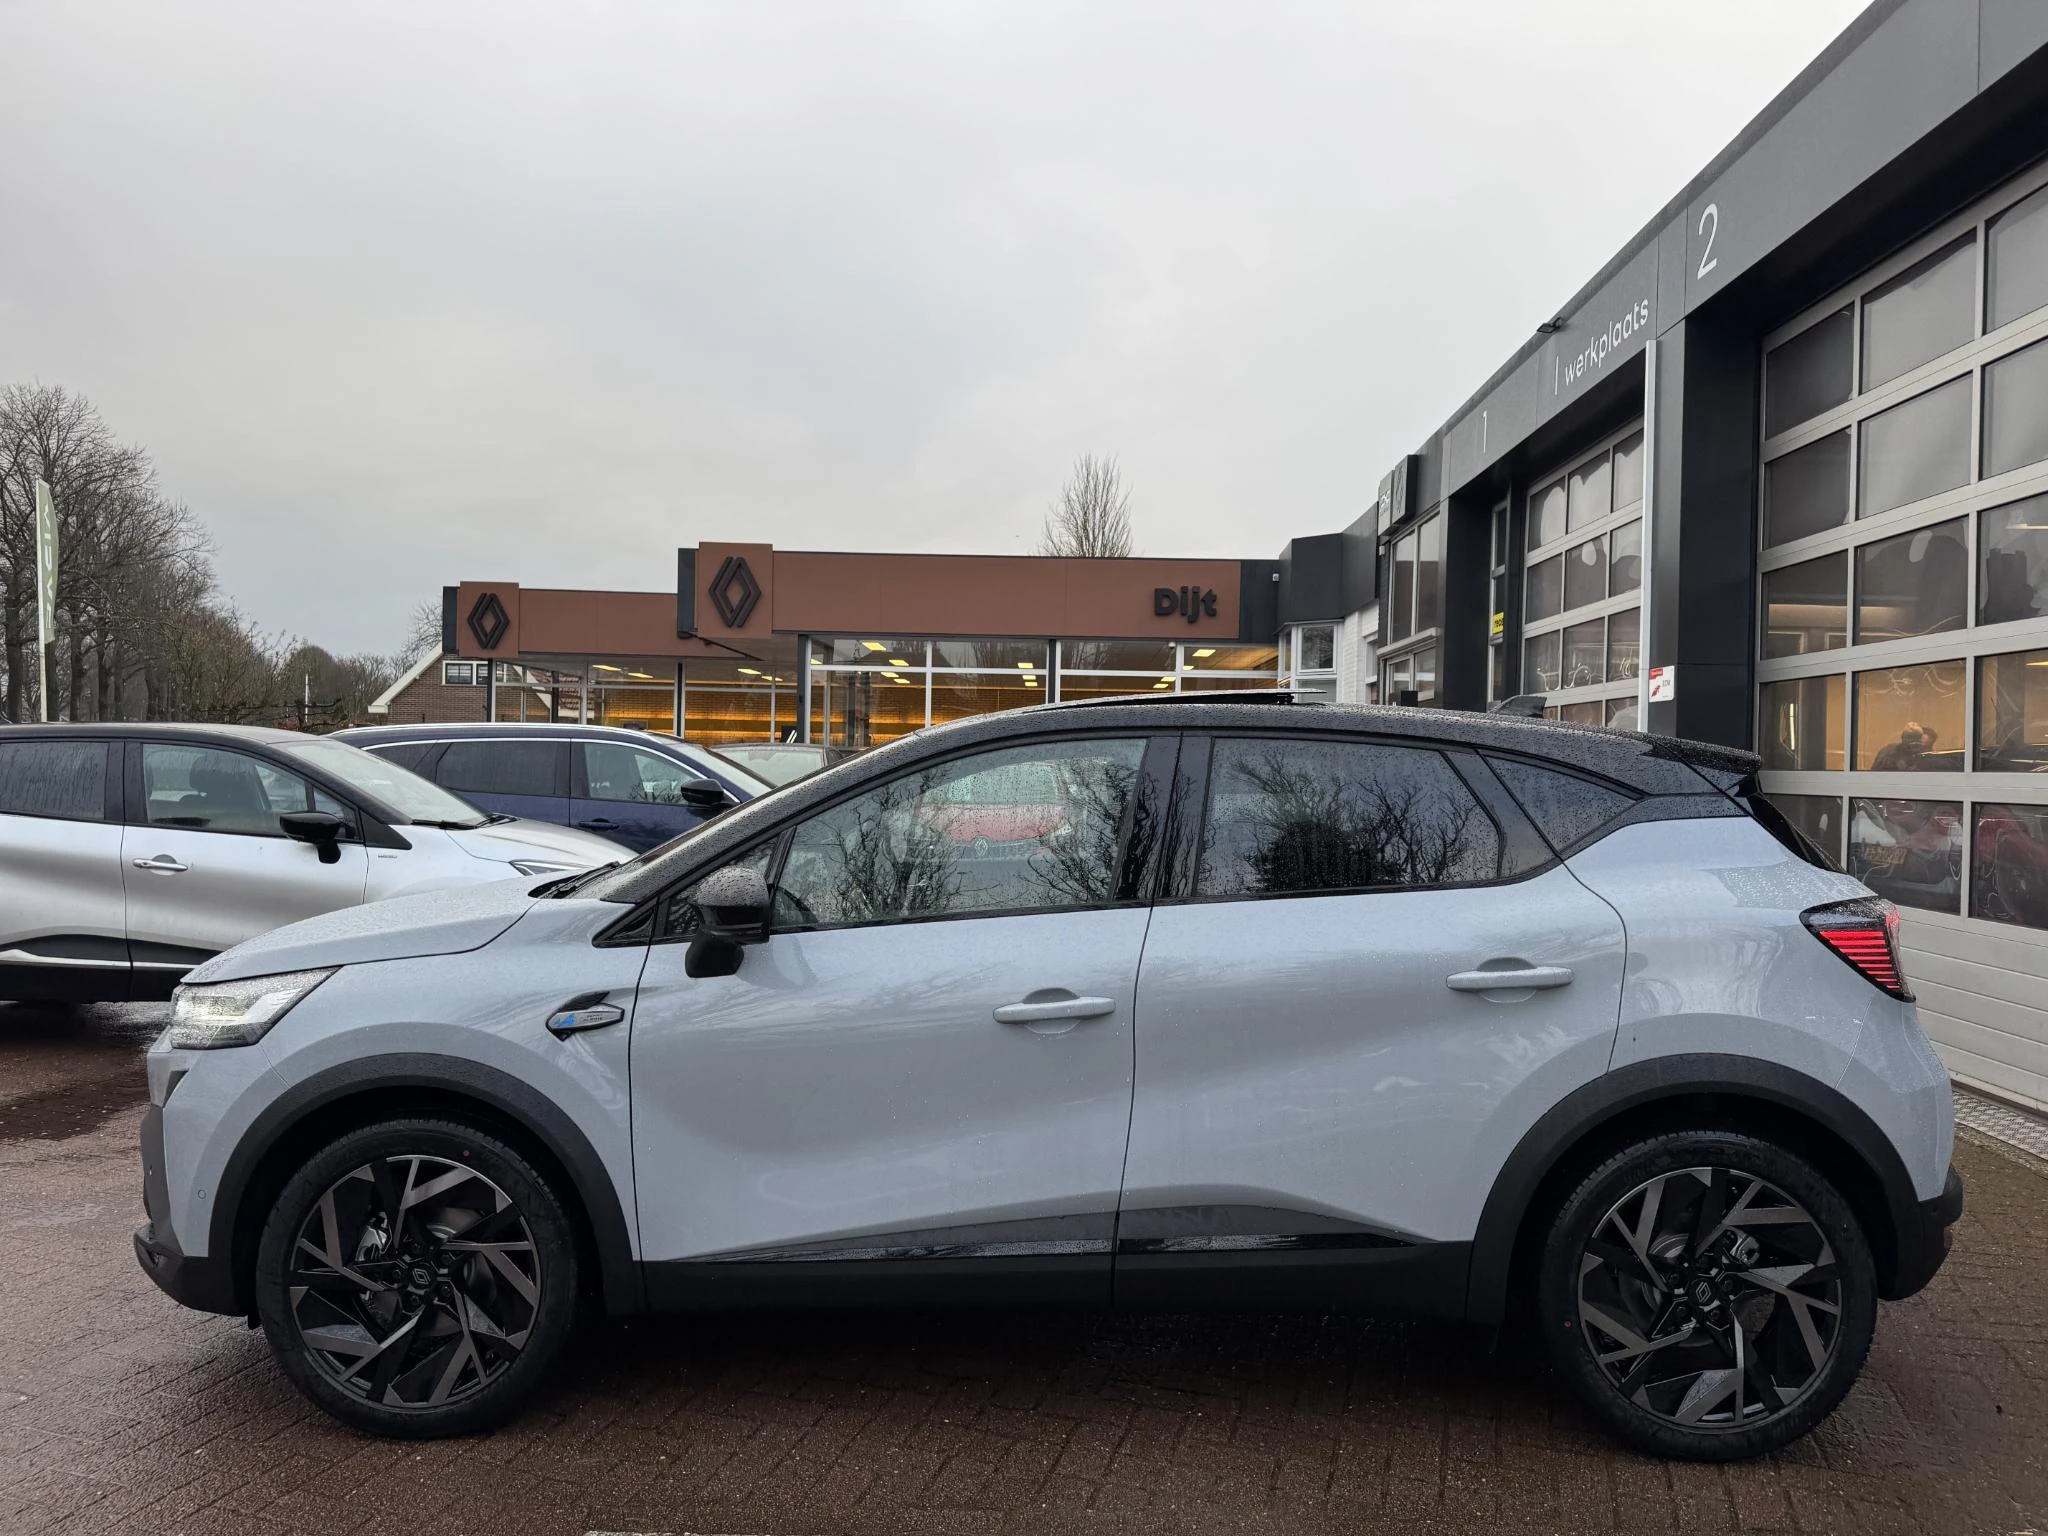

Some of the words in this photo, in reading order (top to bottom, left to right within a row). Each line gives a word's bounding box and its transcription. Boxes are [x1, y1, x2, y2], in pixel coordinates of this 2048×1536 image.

[1697, 203, 1719, 281] 2
[1565, 298, 1649, 387] werkplaats
[1154, 585, 1218, 625] Dijt
